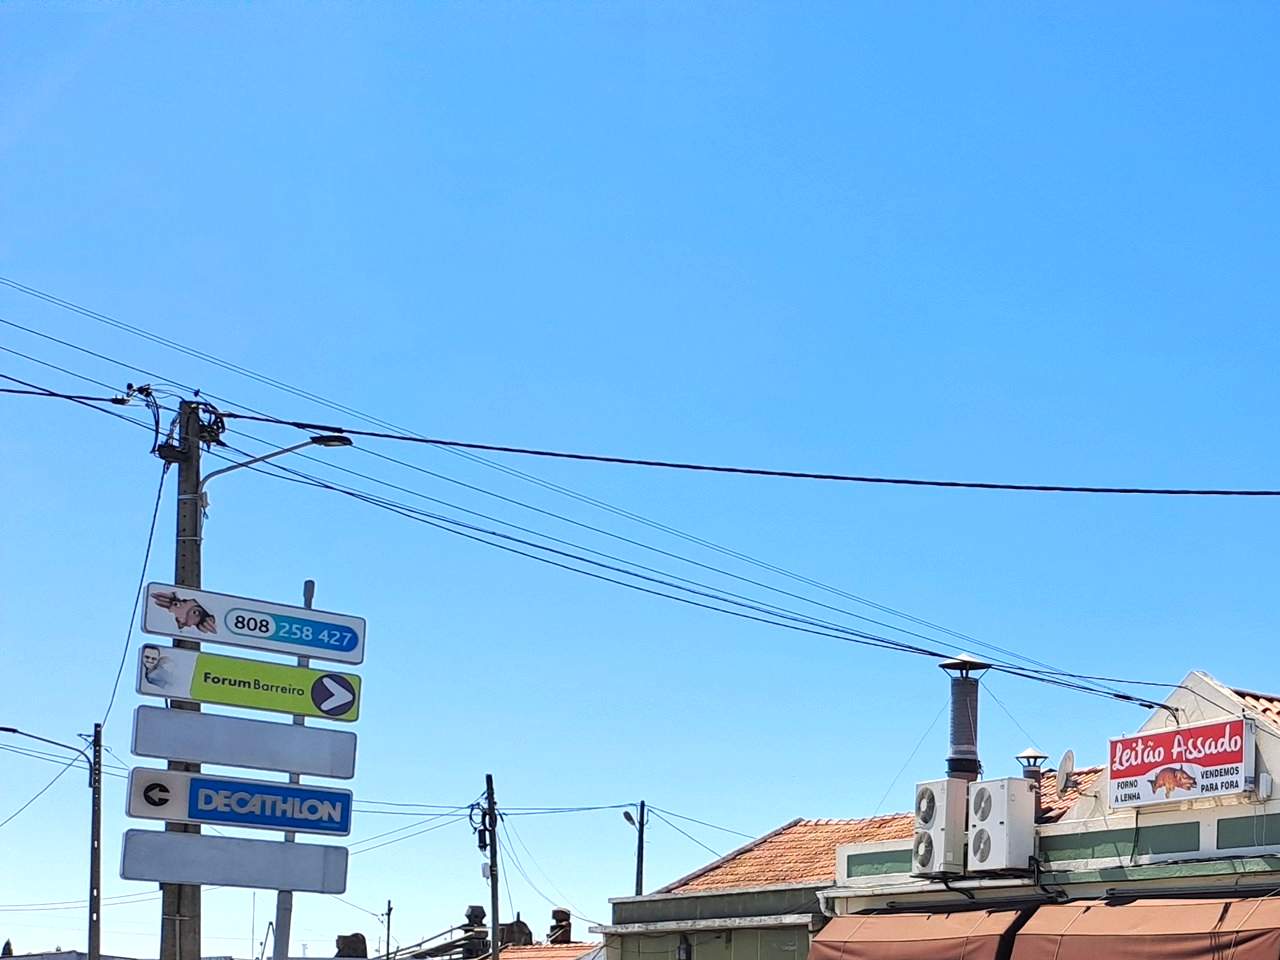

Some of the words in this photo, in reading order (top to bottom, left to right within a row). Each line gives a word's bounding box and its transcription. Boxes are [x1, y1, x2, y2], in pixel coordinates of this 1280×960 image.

[233, 614, 270, 633] 808
[279, 621, 313, 641] 258
[318, 627, 352, 647] 427
[1112, 740, 1164, 770] Leitão
[1171, 724, 1242, 761] Assado
[1200, 766, 1240, 780] VENDEMOS
[1116, 779, 1138, 790] FORNO
[1200, 783, 1219, 793] PARA
[1220, 781, 1240, 791] FORA
[1120, 792, 1141, 803] LENHA
[197, 788, 343, 823] DECATHLON
